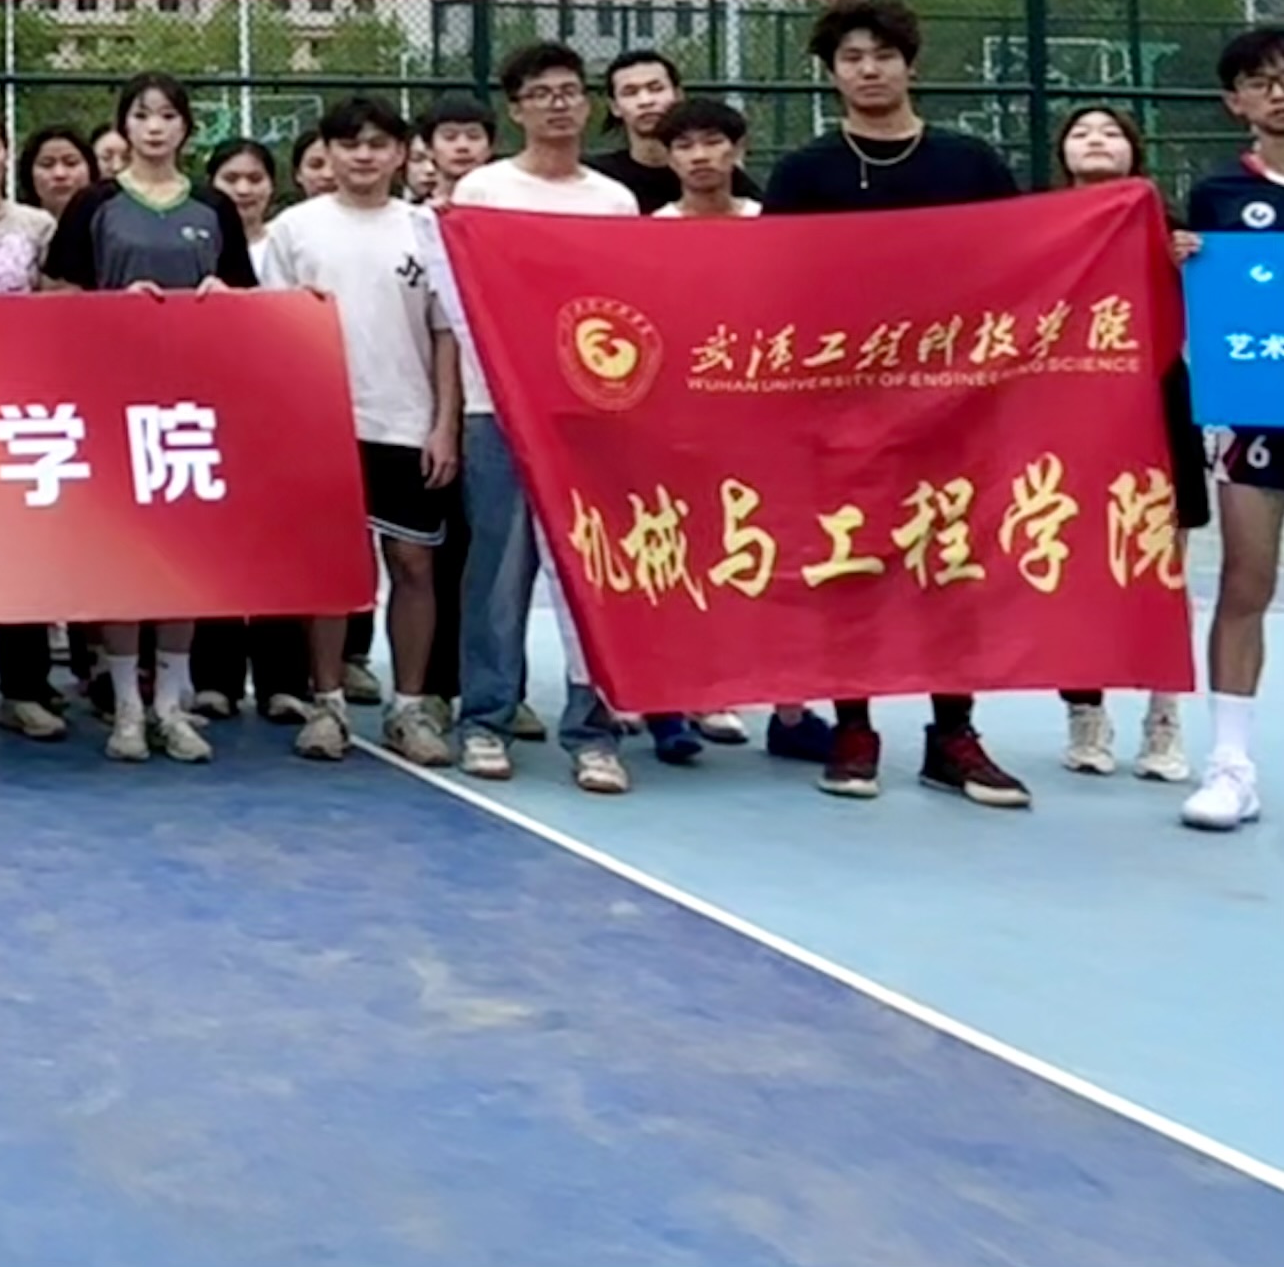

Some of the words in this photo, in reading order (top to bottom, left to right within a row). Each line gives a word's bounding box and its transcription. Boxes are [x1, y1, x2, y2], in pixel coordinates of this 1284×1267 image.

[687, 378, 759, 393] WUHAN
[880, 372, 904, 388] OF
[1047, 356, 1140, 374] SCIENCE
[1247, 434, 1271, 469] 6
[570, 452, 1187, 612] 机械与工程学院
